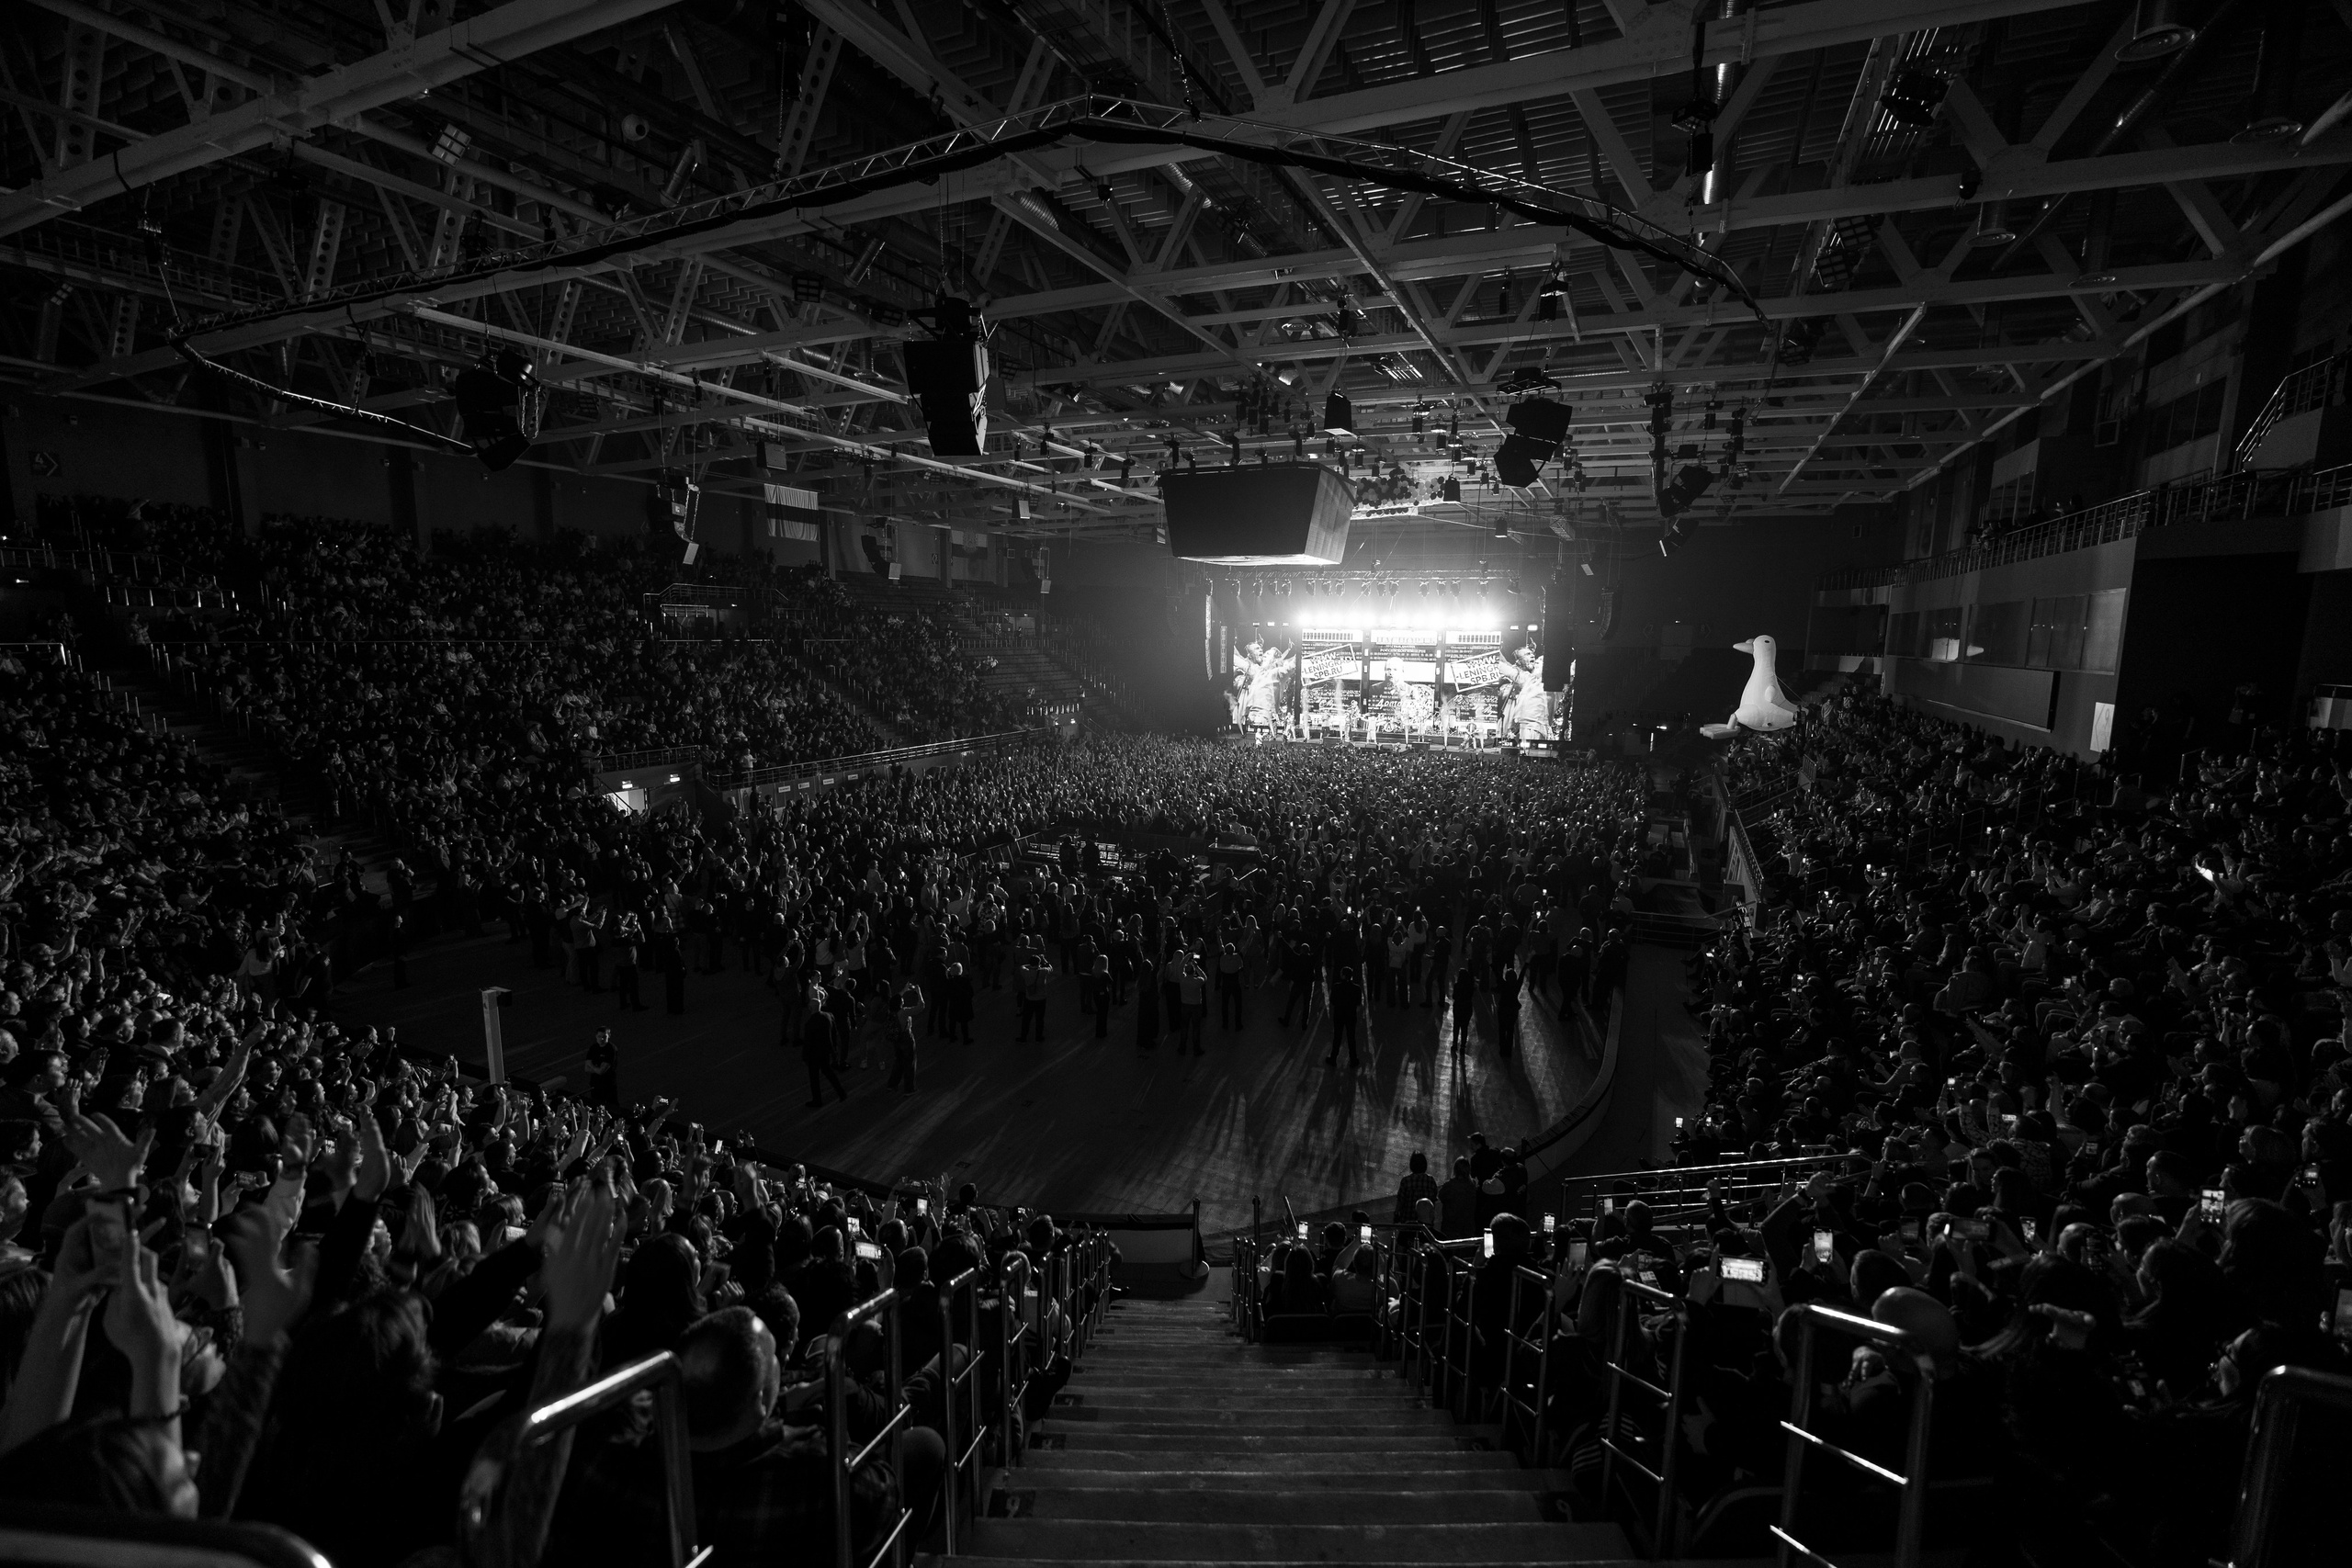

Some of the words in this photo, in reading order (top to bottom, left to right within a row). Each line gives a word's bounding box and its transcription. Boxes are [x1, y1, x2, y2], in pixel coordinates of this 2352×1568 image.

[1314, 666, 1342, 678] SPB.RU
[1006, 1495, 1021, 1517] 9
[1556, 1499, 1573, 1522] 9
